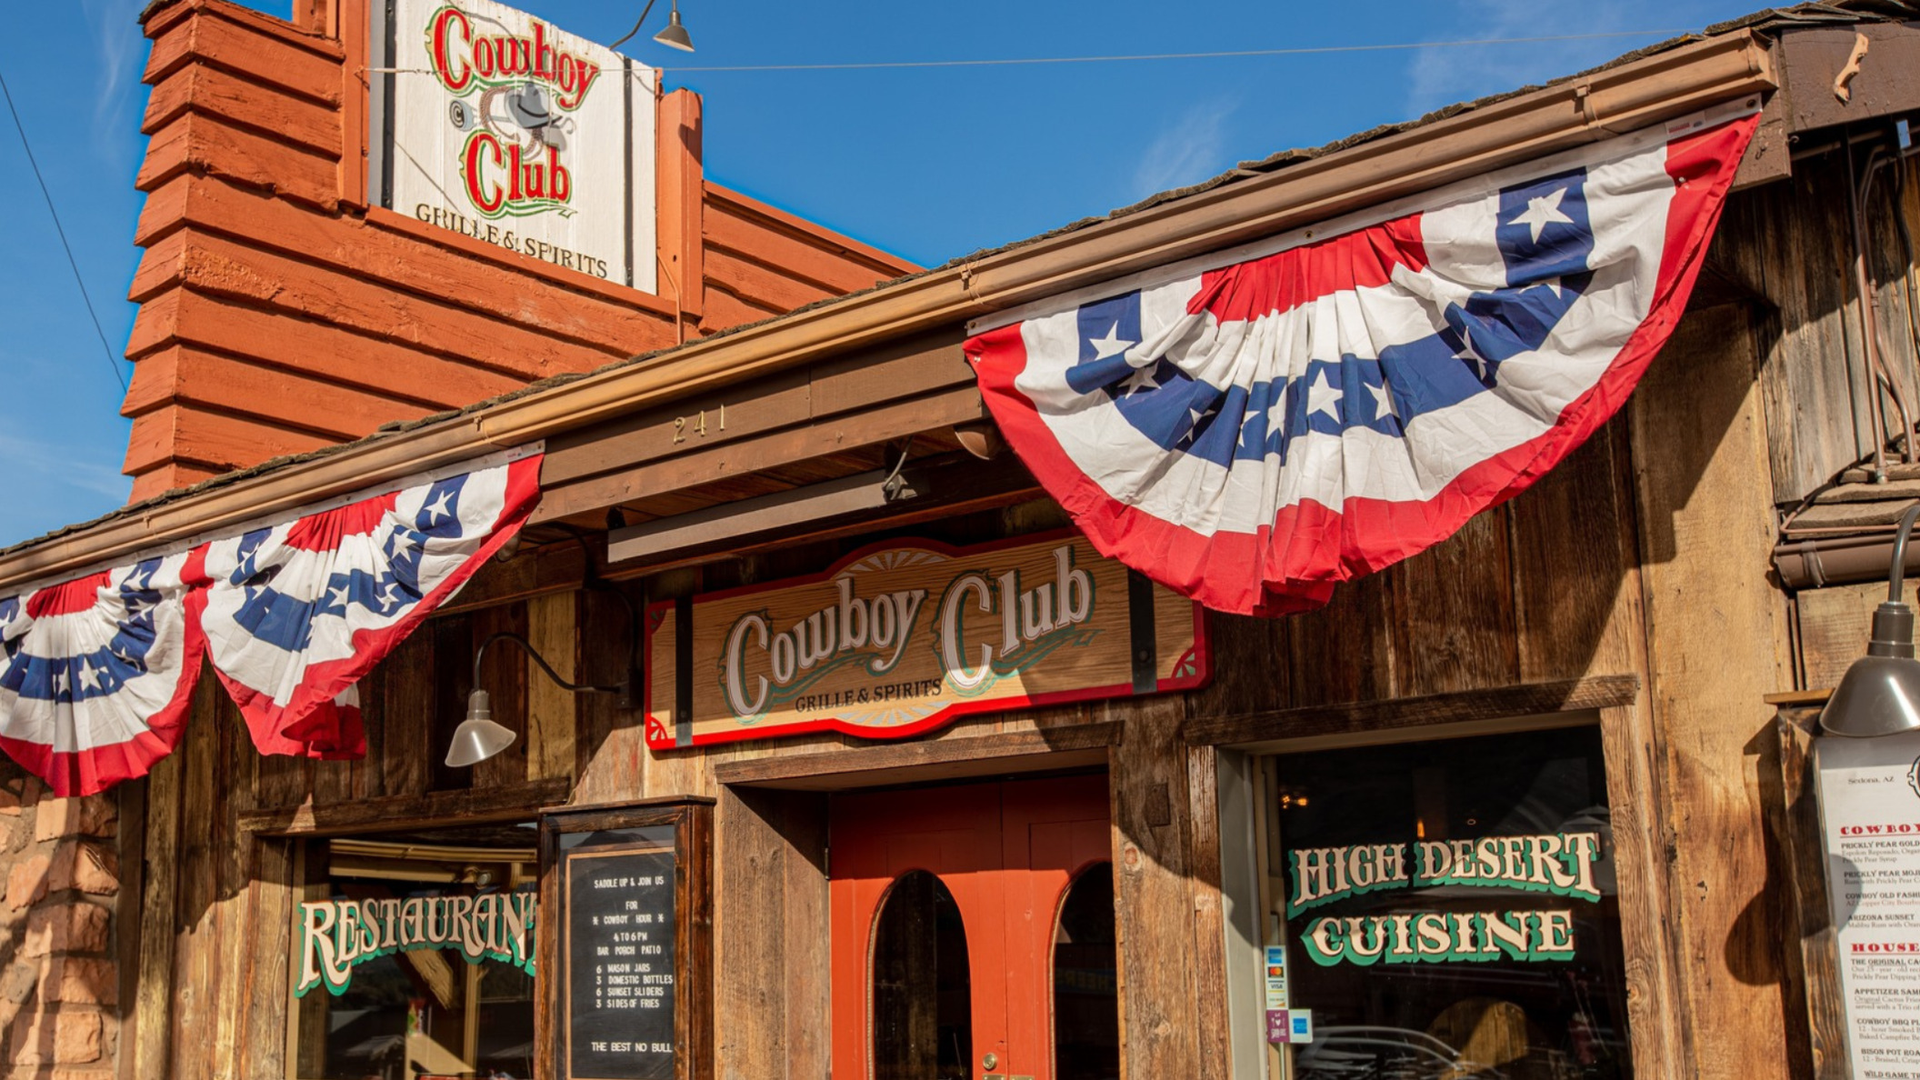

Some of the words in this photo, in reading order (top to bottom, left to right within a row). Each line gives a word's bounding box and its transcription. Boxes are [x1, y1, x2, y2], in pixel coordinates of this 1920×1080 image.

[426, 6, 600, 111] Cowboy
[461, 131, 573, 216] Club
[415, 203, 500, 246] GRILLE
[503, 230, 522, 252] &
[524, 237, 608, 279] SPIRITS
[673, 404, 726, 445] 241
[720, 577, 928, 722] Cowboy
[934, 544, 1095, 695] Club
[795, 690, 854, 713] GRILLE
[857, 688, 869, 704] &
[873, 678, 942, 702] SPIRITS
[1841, 841, 1874, 850] PRICKLY
[1290, 843, 1409, 916] HIGH
[1416, 832, 1601, 902] DESERT
[1844, 870, 1877, 878] PRICKLY
[594, 878, 618, 889] SADDLE
[619, 878, 628, 888] UP
[630, 877, 635, 887] &
[637, 876, 652, 886] JOIN
[654, 876, 664, 885] US
[625, 900, 638, 910] FOR
[603, 914, 628, 925] COWBOY
[635, 913, 652, 924] HOUR
[295, 891, 537, 996] RESTAURAN
[1303, 910, 1575, 965] CUISINE
[597, 946, 609, 956] BAR
[615, 945, 636, 956] PORCH
[641, 944, 662, 955] PATIO
[1850, 942, 1920, 953] HOUSE
[1867, 958, 1906, 966] ORIGINAL
[596, 965, 602, 974] 6
[607, 963, 631, 973] MASON
[634, 963, 651, 973] JARS
[608, 975, 640, 985] DOMESTIC
[643, 974, 674, 985] BOTTLES
[596, 987, 602, 997] 6
[607, 987, 632, 997] SUNSET
[634, 986, 664, 997] SLIDERS
[640, 998, 660, 1008] FRIES
[1892, 1018, 1909, 1026] BBQ
[591, 1041, 607, 1052] THE
[611, 1042, 632, 1052] BEST
[635, 1043, 647, 1052] NO
[651, 1043, 673, 1053] BULL
[1863, 1070, 1884, 1078] WILD
[1885, 1071, 1910, 1079] GAME
